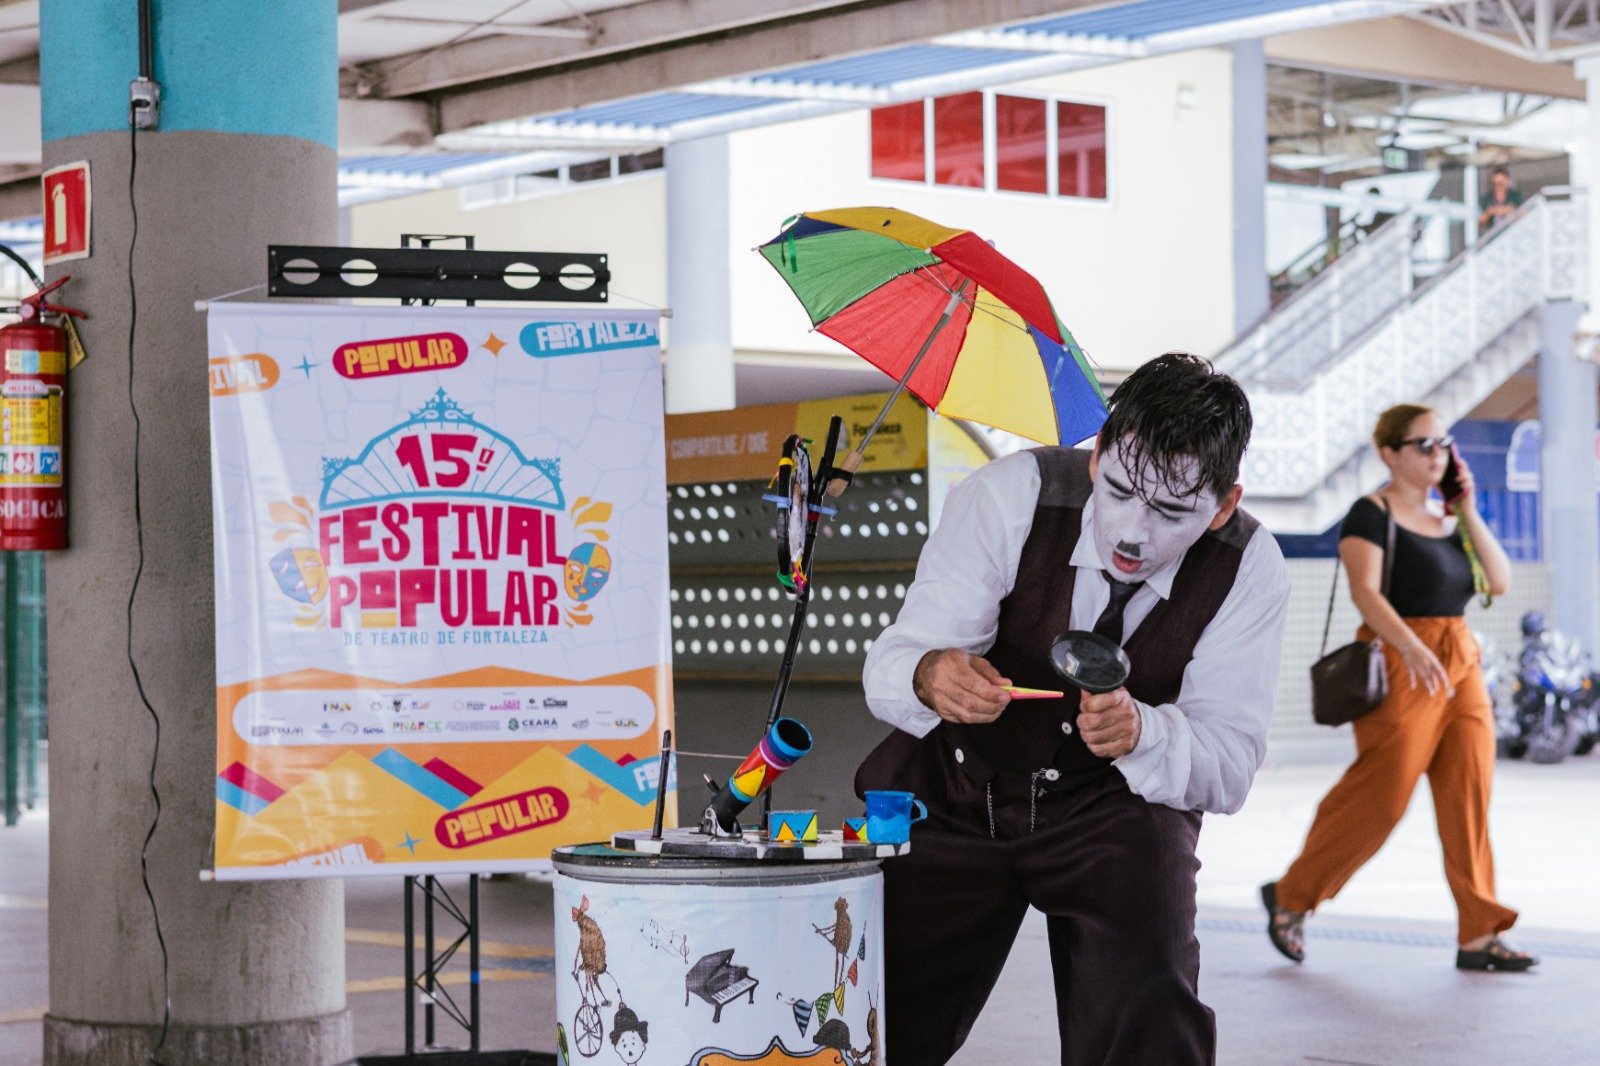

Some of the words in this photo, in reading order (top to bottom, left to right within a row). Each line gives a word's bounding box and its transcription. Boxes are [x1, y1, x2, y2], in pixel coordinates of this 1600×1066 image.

[344, 338, 457, 376] POPULAR
[319, 502, 568, 567] FESTIVAL
[329, 568, 559, 628] POPULAR
[344, 631, 363, 646] DE
[371, 631, 430, 646] TEATRO
[437, 630, 456, 645] DE
[463, 630, 549, 645] FORTALEZA
[522, 717, 558, 727] CEARÁ
[444, 794, 558, 847] POPULAR
